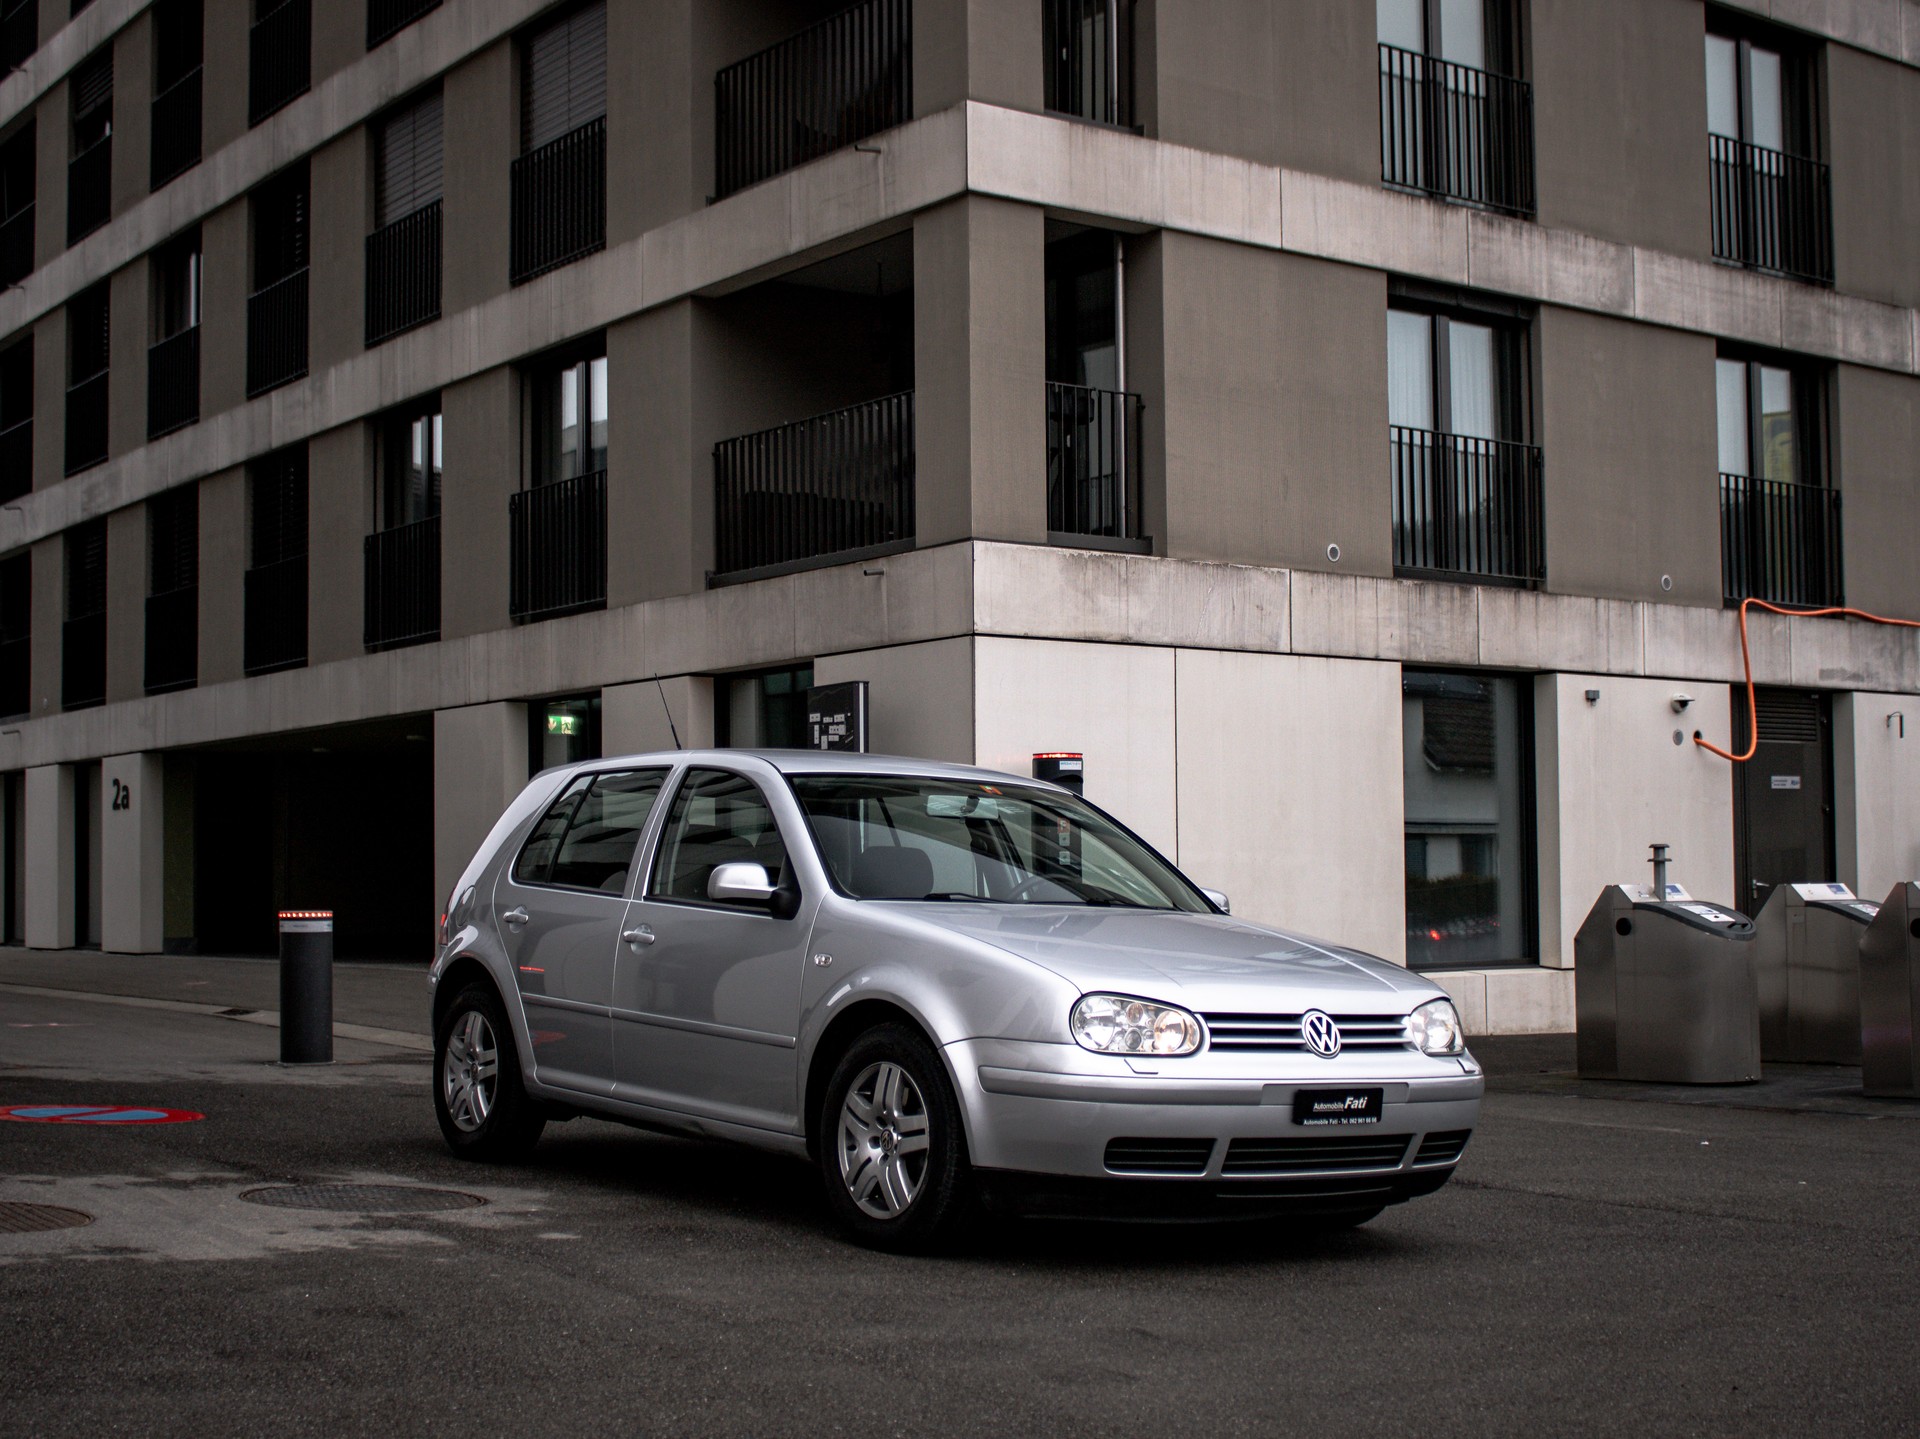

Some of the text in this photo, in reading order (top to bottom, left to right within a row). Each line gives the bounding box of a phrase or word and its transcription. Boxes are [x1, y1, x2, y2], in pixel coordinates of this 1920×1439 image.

[112, 778, 129, 810] 2a
[1303, 1011, 1340, 1057] VW
[1313, 1096, 1368, 1111] Automobile Fati
